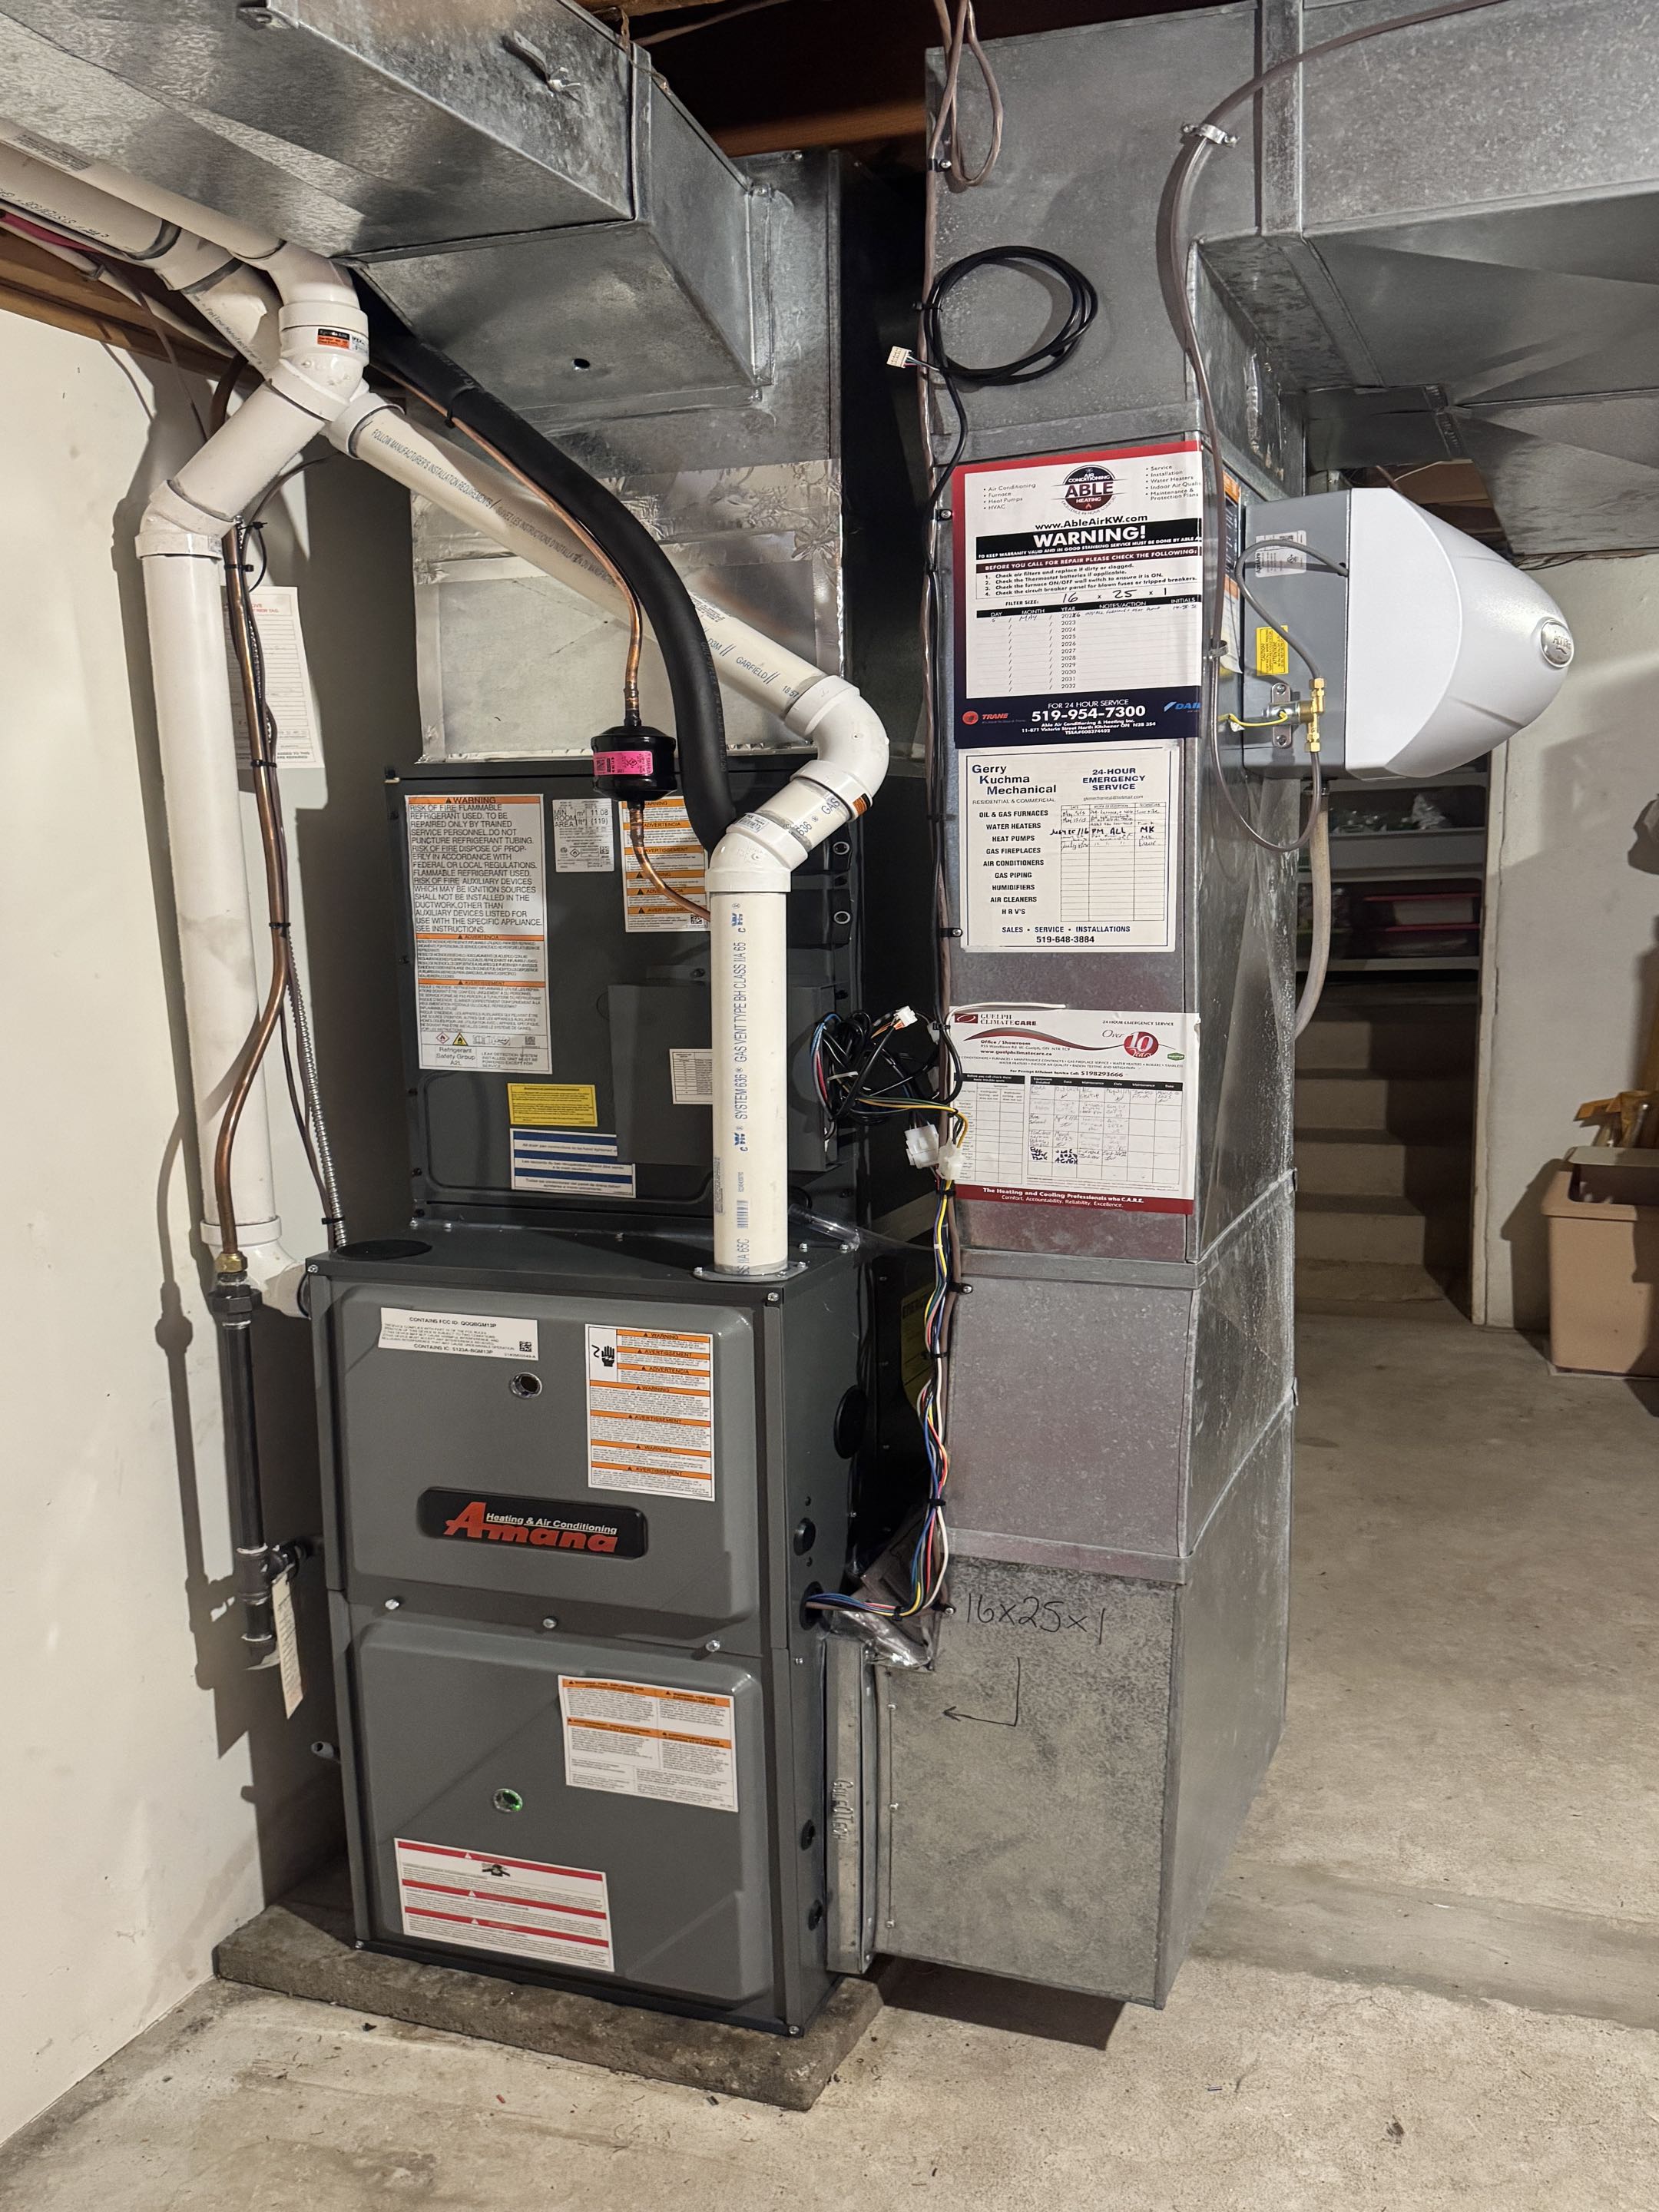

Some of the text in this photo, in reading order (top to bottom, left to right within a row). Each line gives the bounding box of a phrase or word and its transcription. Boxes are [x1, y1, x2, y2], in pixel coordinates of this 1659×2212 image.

[372, 429, 392, 445] FOLLOW
[428, 464, 460, 486] INSTALLATION
[1065, 482, 1113, 498] ABLE
[1035, 516, 1147, 530] www.AbleAirKW.com
[1033, 525, 1146, 547] WARNING!
[1063, 592, 1078, 603] 16
[1113, 590, 1137, 598] 25
[736, 657, 768, 679] GARFIELD
[1031, 705, 1146, 722] 519-954-7300
[972, 765, 1007, 774] Gerry
[980, 776, 1030, 784] Kuchma
[987, 785, 1056, 795] Mechanical
[796, 798, 840, 836] 636 GAS
[733, 942, 746, 951] 65
[733, 964, 746, 988] CLASS
[733, 990, 746, 1001] BH
[734, 1003, 746, 1022] TYPE
[734, 1024, 747, 1045] VENT
[1129, 1032, 1153, 1052] 10
[735, 1046, 747, 1062] GAS
[735, 1074, 747, 1088] 636
[735, 1088, 747, 1119] SYSTEM
[645, 1349, 691, 1357] AVERTISSEMENT
[443, 1501, 618, 1552] Amana
[486, 1513, 524, 1524] Heating
[553, 1520, 618, 1534] Conditioning
